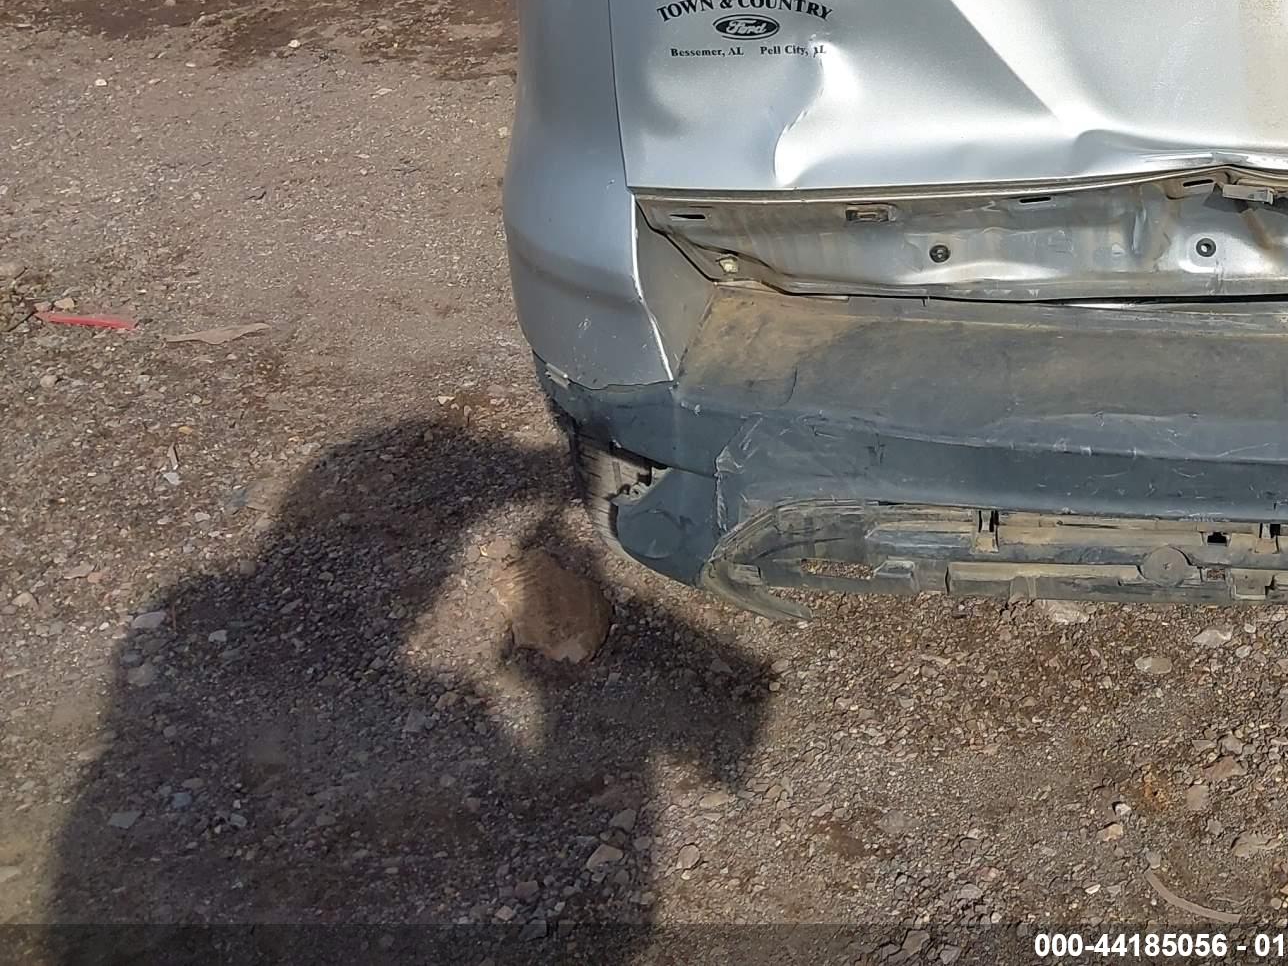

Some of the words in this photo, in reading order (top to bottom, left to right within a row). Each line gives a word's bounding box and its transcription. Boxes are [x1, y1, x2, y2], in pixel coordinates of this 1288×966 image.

[726, 19, 767, 35] Ford
[670, 48, 725, 57] Bessemer,
[727, 48, 744, 56] AL
[760, 46, 781, 55] Pell
[784, 45, 808, 57] City,
